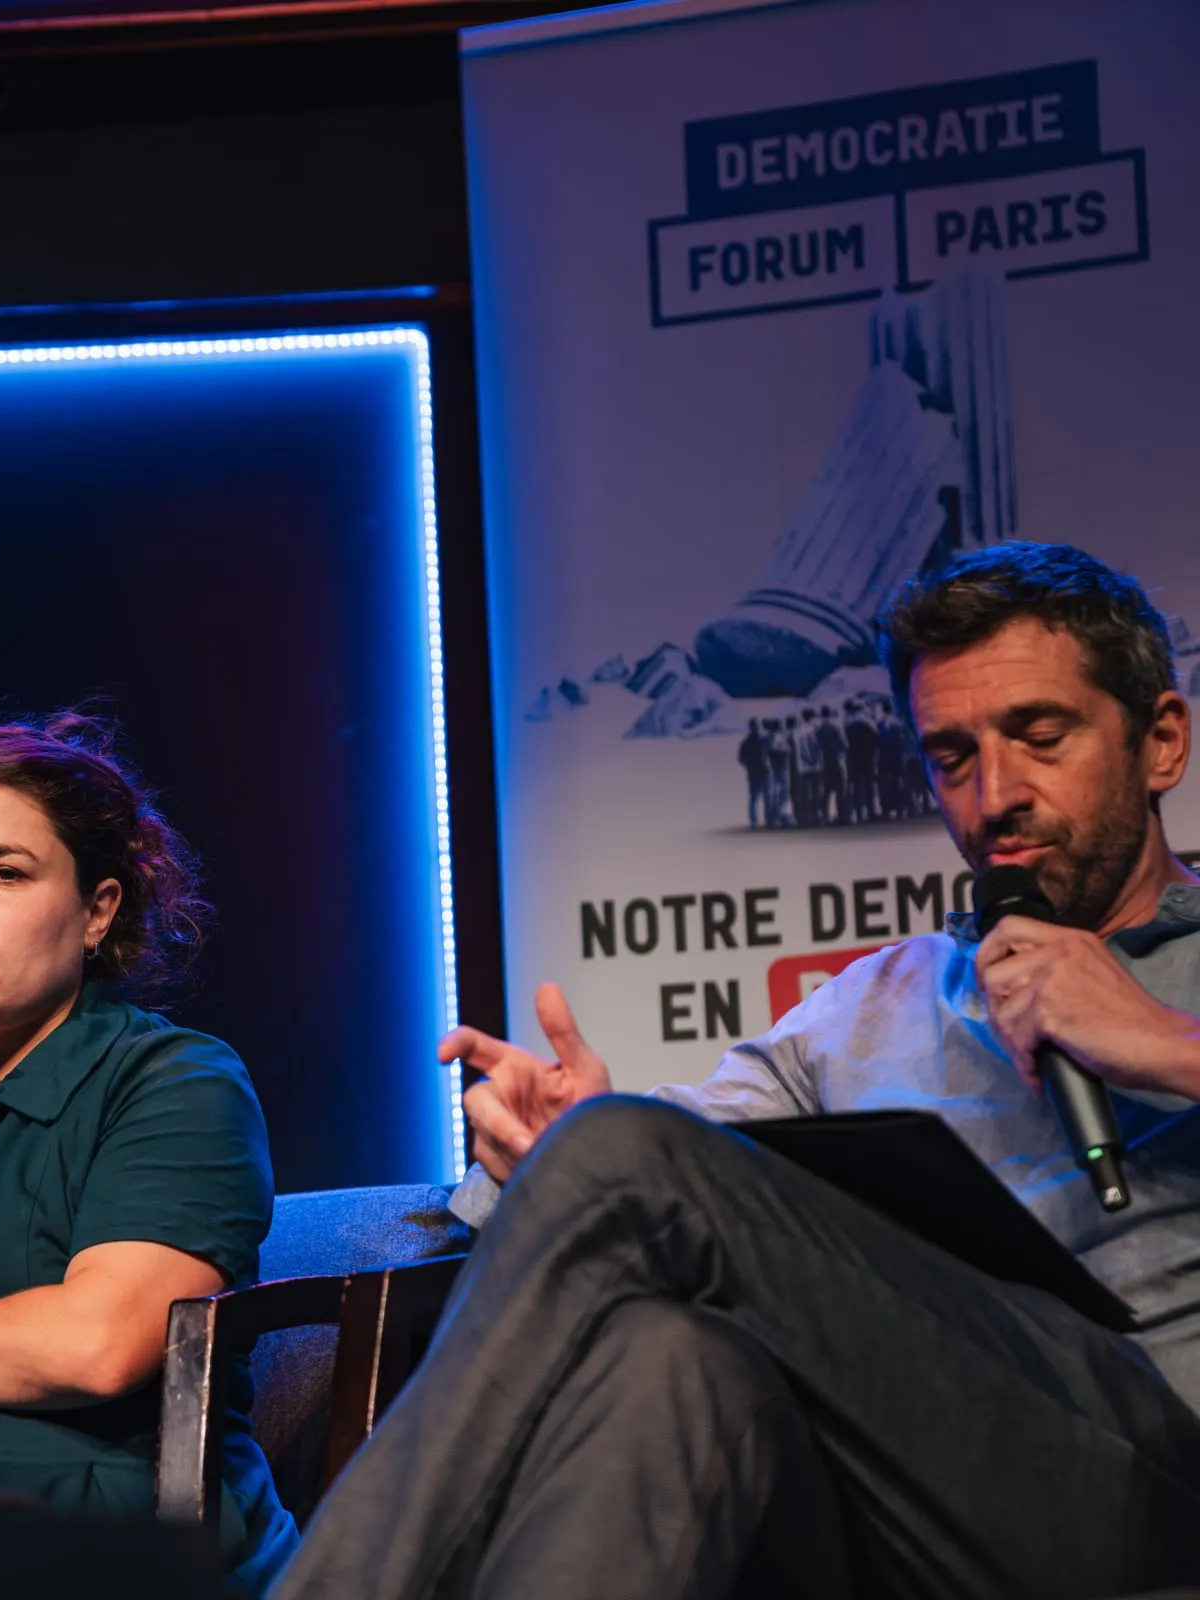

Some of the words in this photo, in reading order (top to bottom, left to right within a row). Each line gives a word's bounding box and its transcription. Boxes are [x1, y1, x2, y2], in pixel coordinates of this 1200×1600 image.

[716, 94, 1063, 190] DEMOCRATIE
[688, 224, 865, 292] FORUM
[935, 190, 1108, 257] PARIS
[580, 887, 782, 960] NOTRE
[660, 979, 742, 1042] EN
